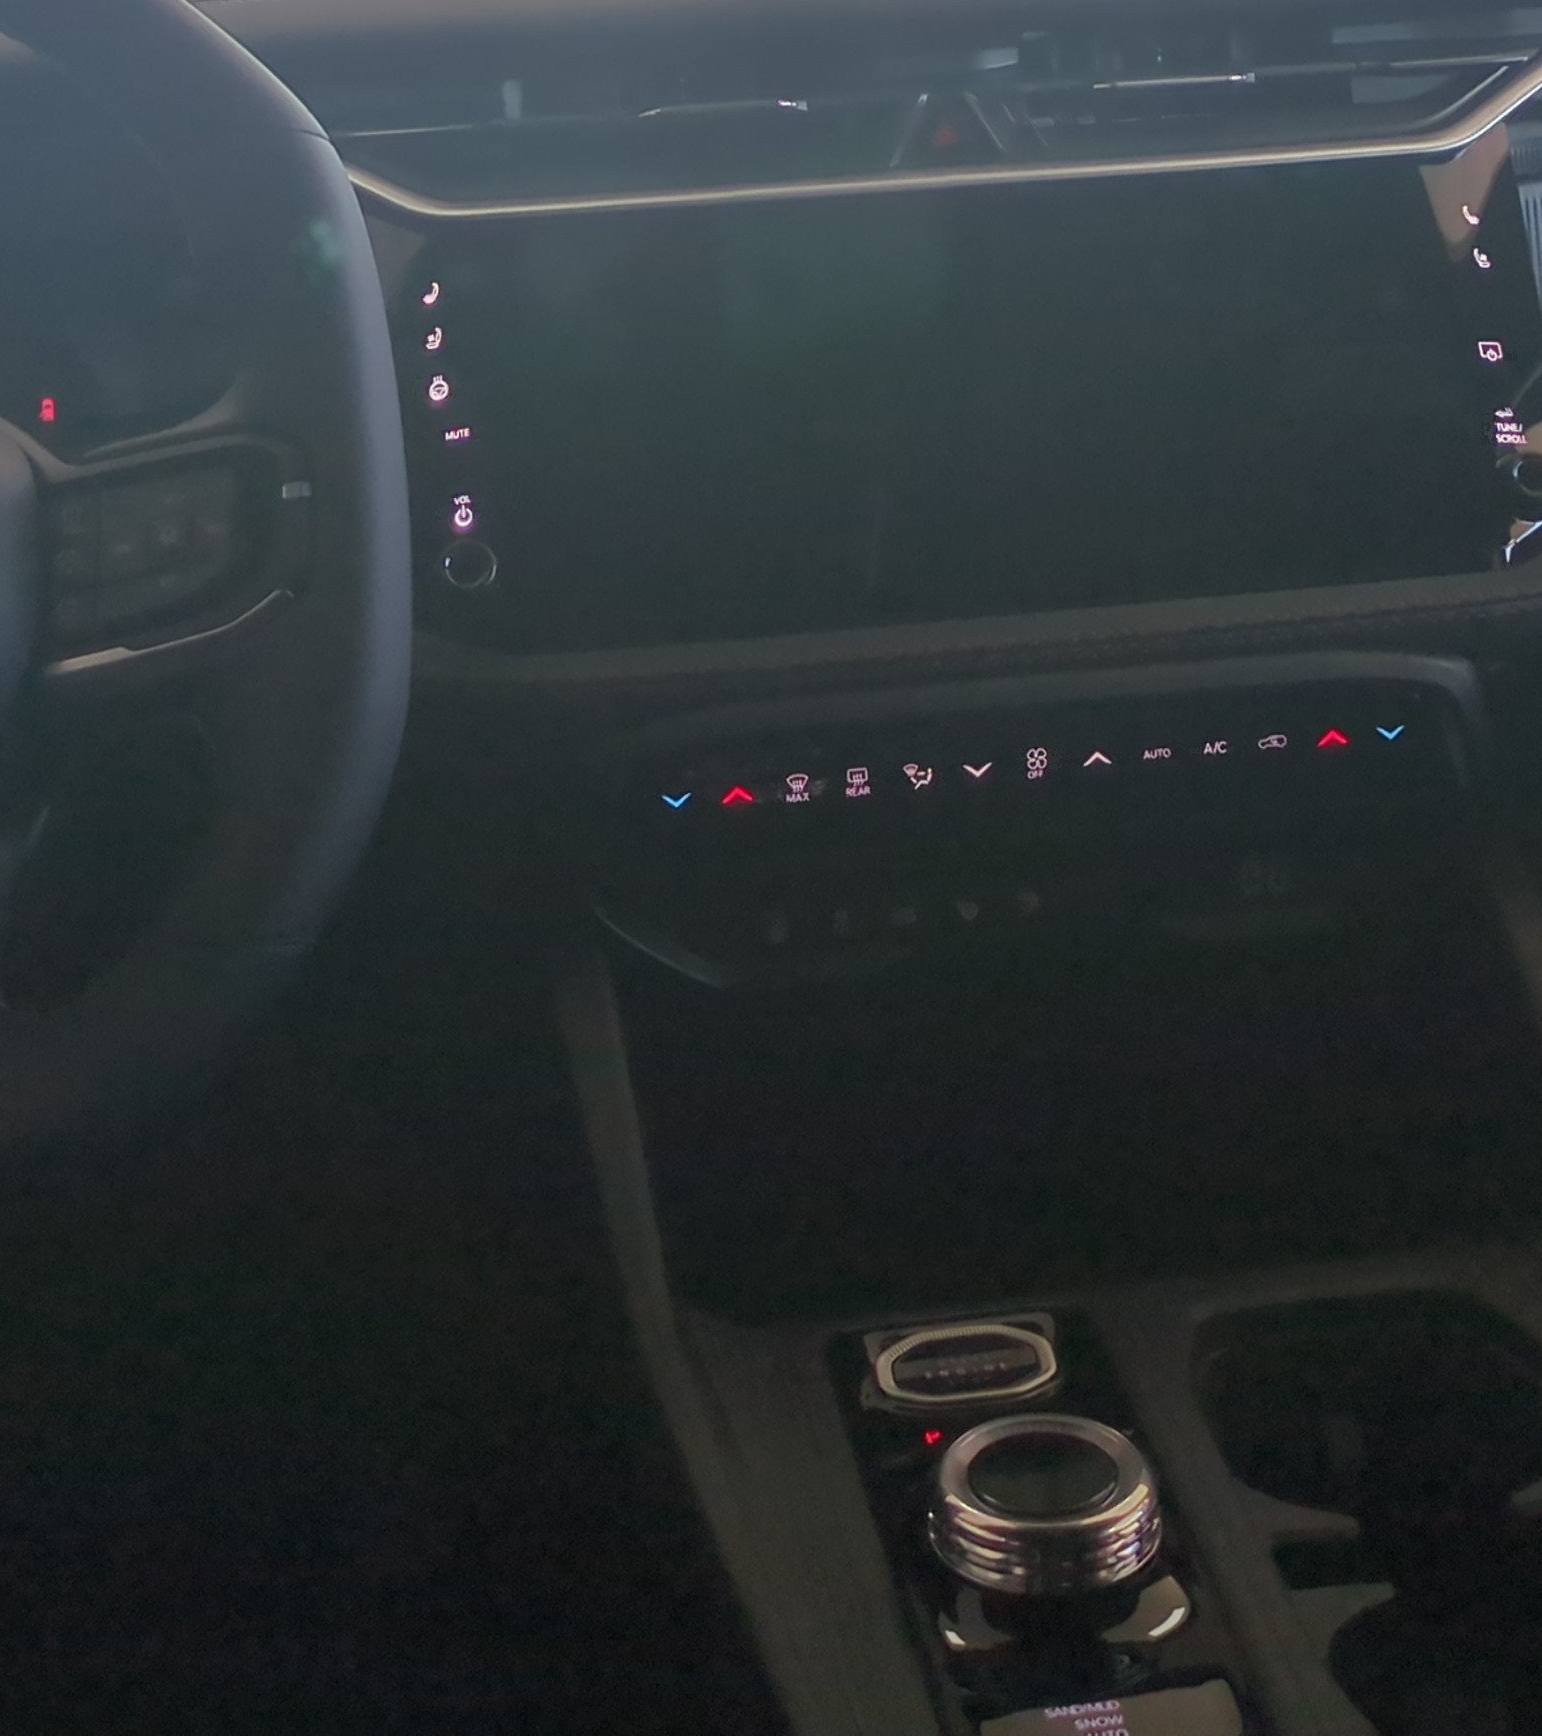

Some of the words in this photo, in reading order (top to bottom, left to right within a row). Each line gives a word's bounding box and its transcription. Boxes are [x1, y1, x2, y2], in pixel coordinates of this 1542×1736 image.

[445, 428, 470, 441] MUTE
[1495, 433, 1529, 444] SCROLL
[453, 494, 471, 506] VOL
[1142, 747, 1172, 761] AUTO
[1203, 740, 1228, 756] A/C
[1027, 769, 1045, 780] OFF
[785, 792, 811, 803] MAX
[845, 786, 871, 798] REAR
[1044, 1700, 1121, 1719] SAND/MUD
[1074, 1714, 1124, 1730] SNOW
